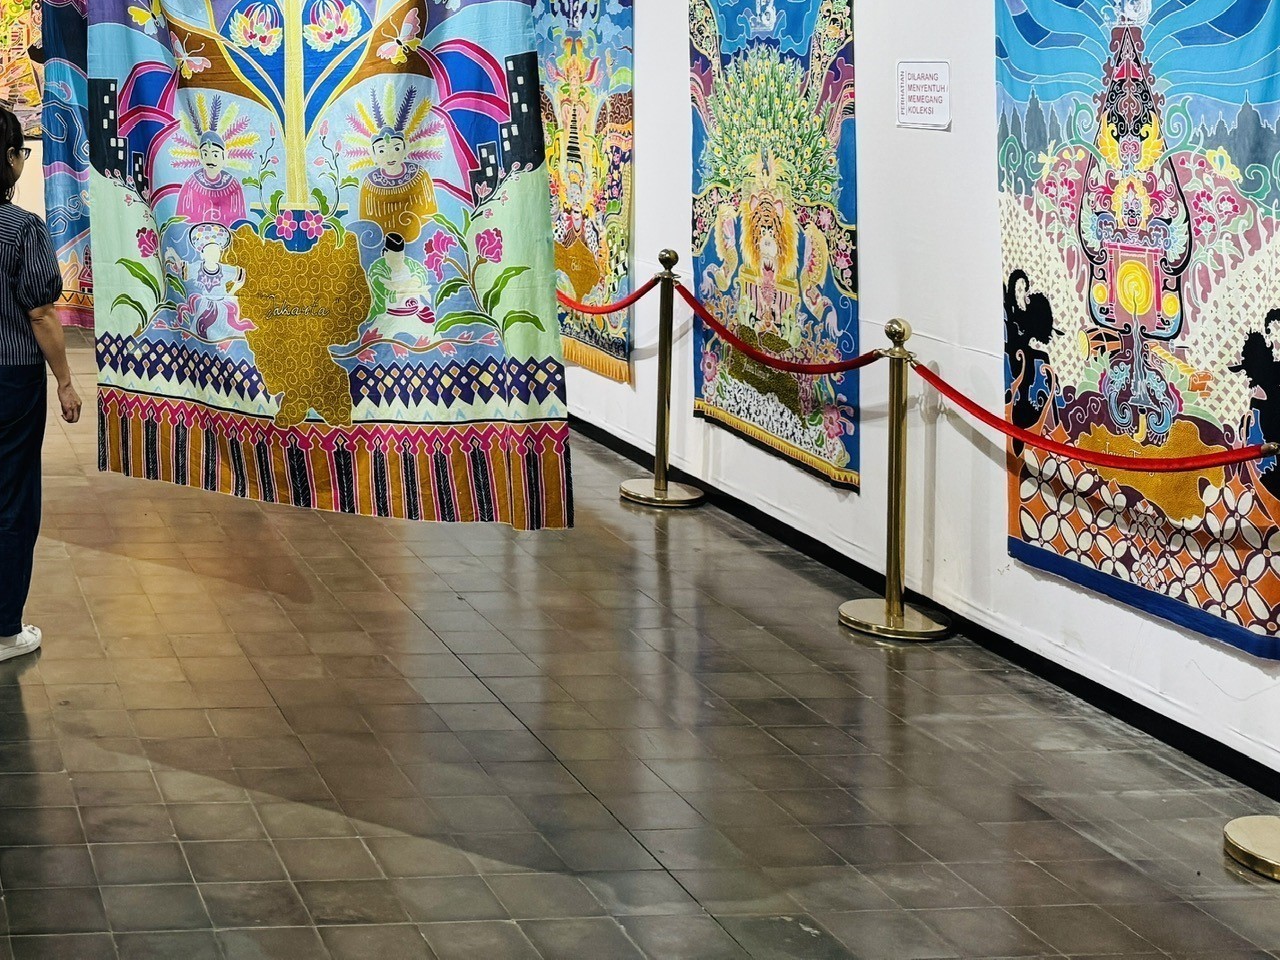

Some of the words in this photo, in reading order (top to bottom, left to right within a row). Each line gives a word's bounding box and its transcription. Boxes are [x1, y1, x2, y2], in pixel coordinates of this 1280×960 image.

[907, 72, 939, 81] DILARANG
[907, 84, 945, 92] MENYENTUH
[907, 95, 943, 104] MEMEGANG
[907, 106, 934, 115] KOLEKSI
